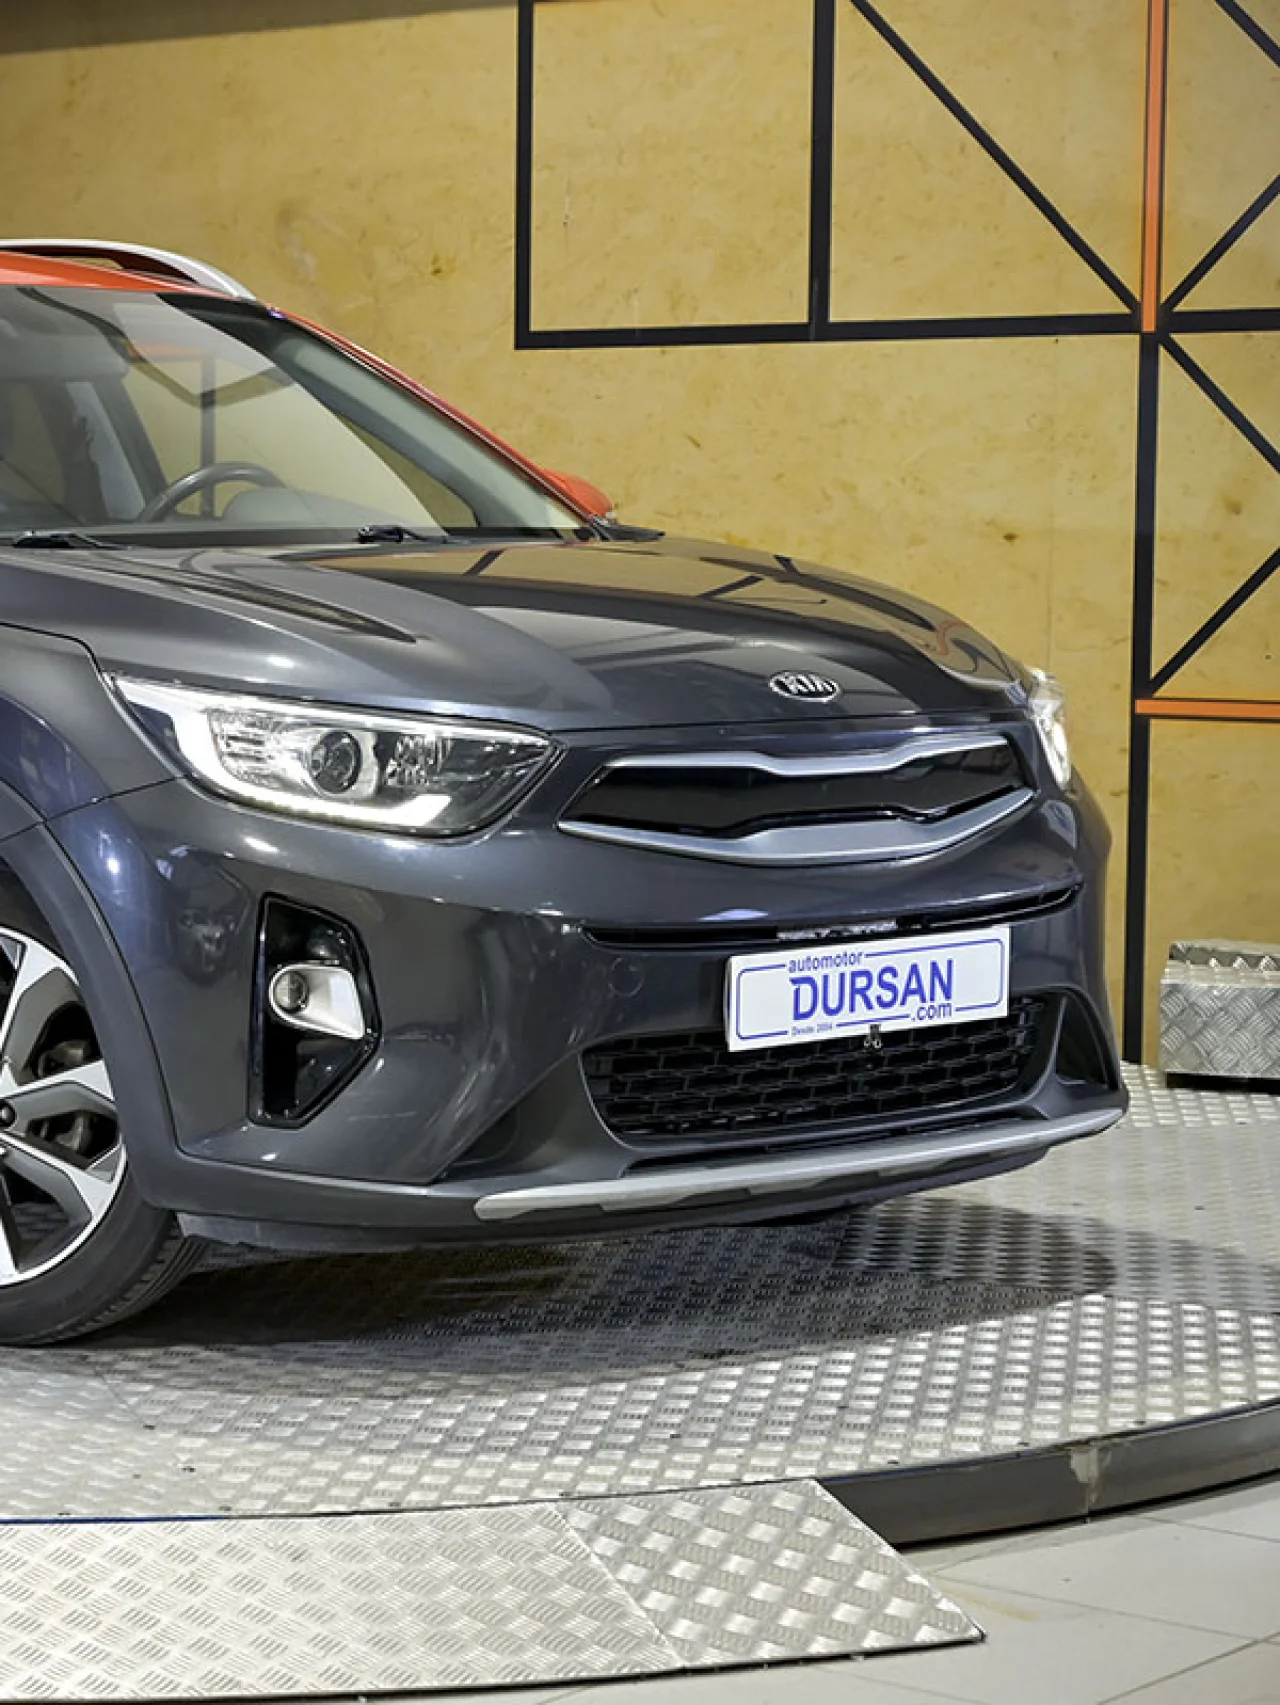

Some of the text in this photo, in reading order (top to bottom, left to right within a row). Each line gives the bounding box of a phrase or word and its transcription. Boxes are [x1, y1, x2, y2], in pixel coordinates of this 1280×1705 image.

[784, 674, 834, 694] KIA
[788, 951, 862, 973] automotor
[789, 958, 953, 1021] DURSAN
[910, 1001, 952, 1022] .com
